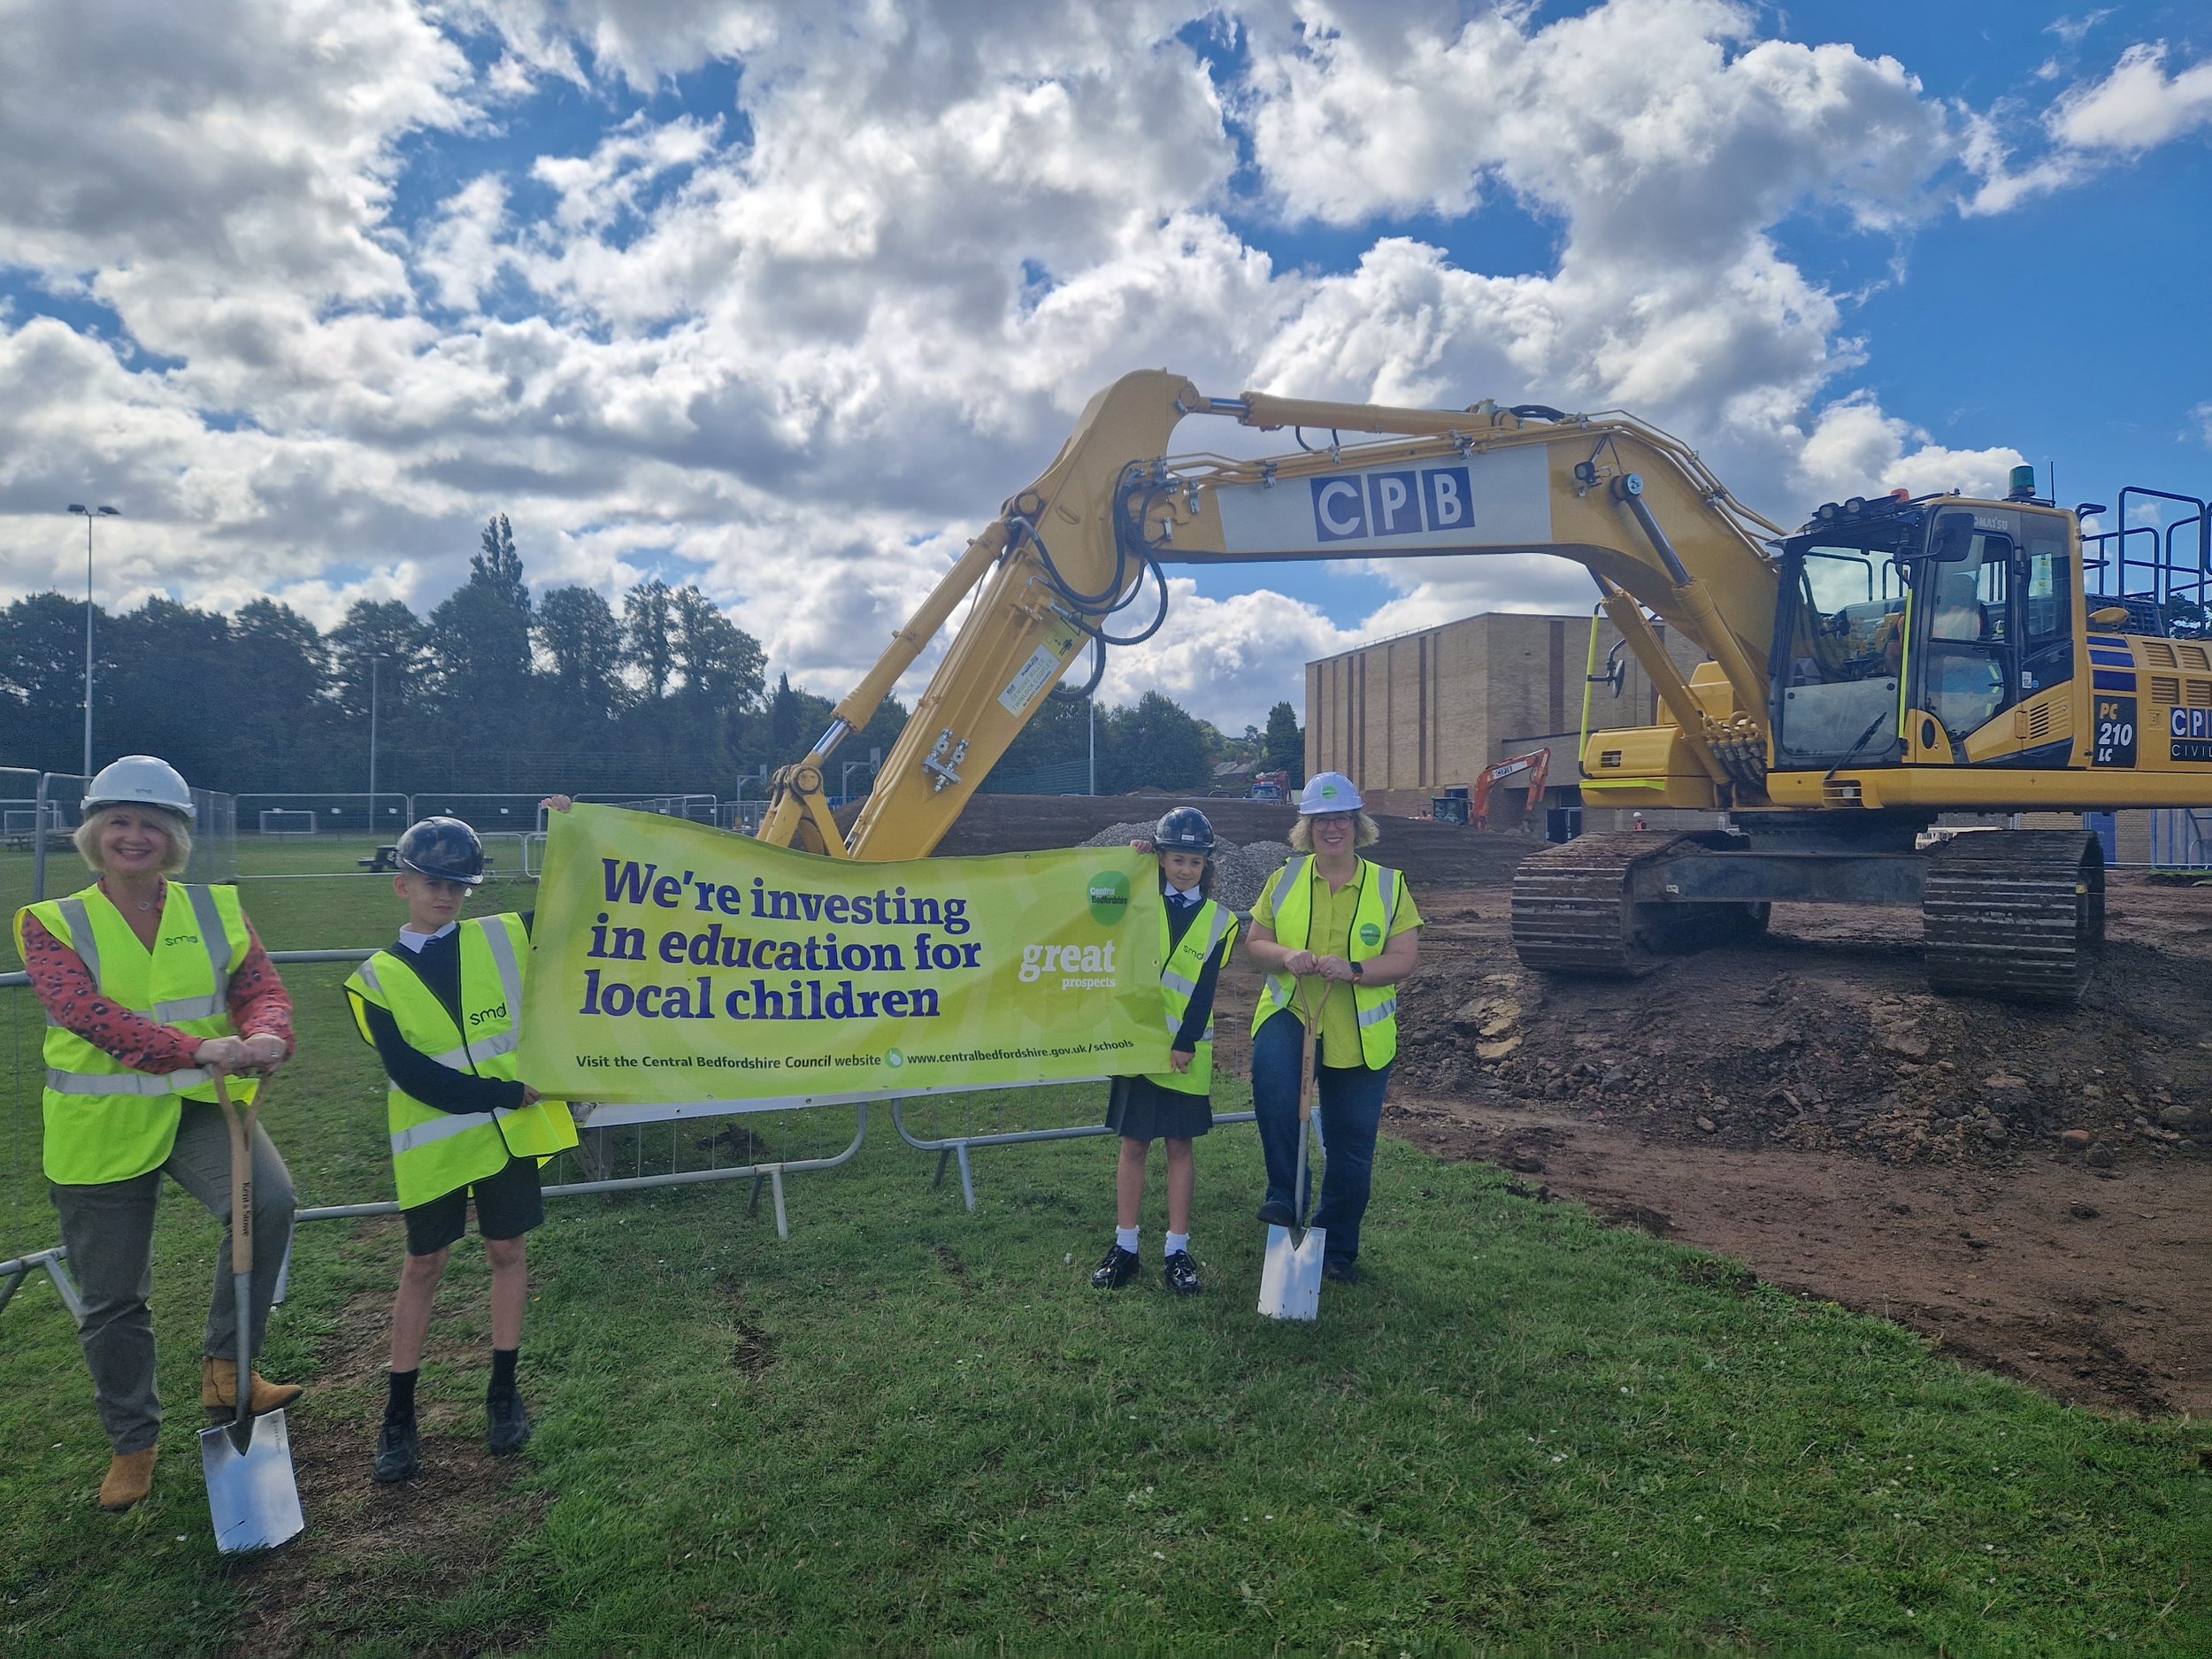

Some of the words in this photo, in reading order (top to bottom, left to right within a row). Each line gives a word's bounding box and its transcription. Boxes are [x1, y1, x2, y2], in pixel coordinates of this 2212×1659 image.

[1318, 473, 1463, 536] CPB
[2100, 703, 2118, 720] PC
[2171, 709, 2212, 736] CP
[2098, 722, 2133, 746] 210
[2098, 748, 2113, 762] LC
[602, 857, 741, 915] We're
[750, 877, 971, 935] investing
[587, 912, 647, 961] in
[658, 923, 906, 972] education
[914, 933, 982, 971] for
[1018, 940, 1117, 983] great
[580, 969, 716, 1019] local
[725, 979, 941, 1020] children
[1062, 977, 1117, 990] prospects
[469, 1002, 507, 1025] smd
[576, 1056, 610, 1068] Visit
[614, 1056, 638, 1068] the
[642, 1056, 693, 1068] Central
[696, 1056, 781, 1069] Bedfordshire
[785, 1055, 832, 1068] Council
[834, 1054, 882, 1067] website
[907, 1039, 1134, 1064] www.centralbedfordshire.gov.uk/schools
[242, 1181, 251, 1202] Kent
[242, 1210, 251, 1237] Stowe
